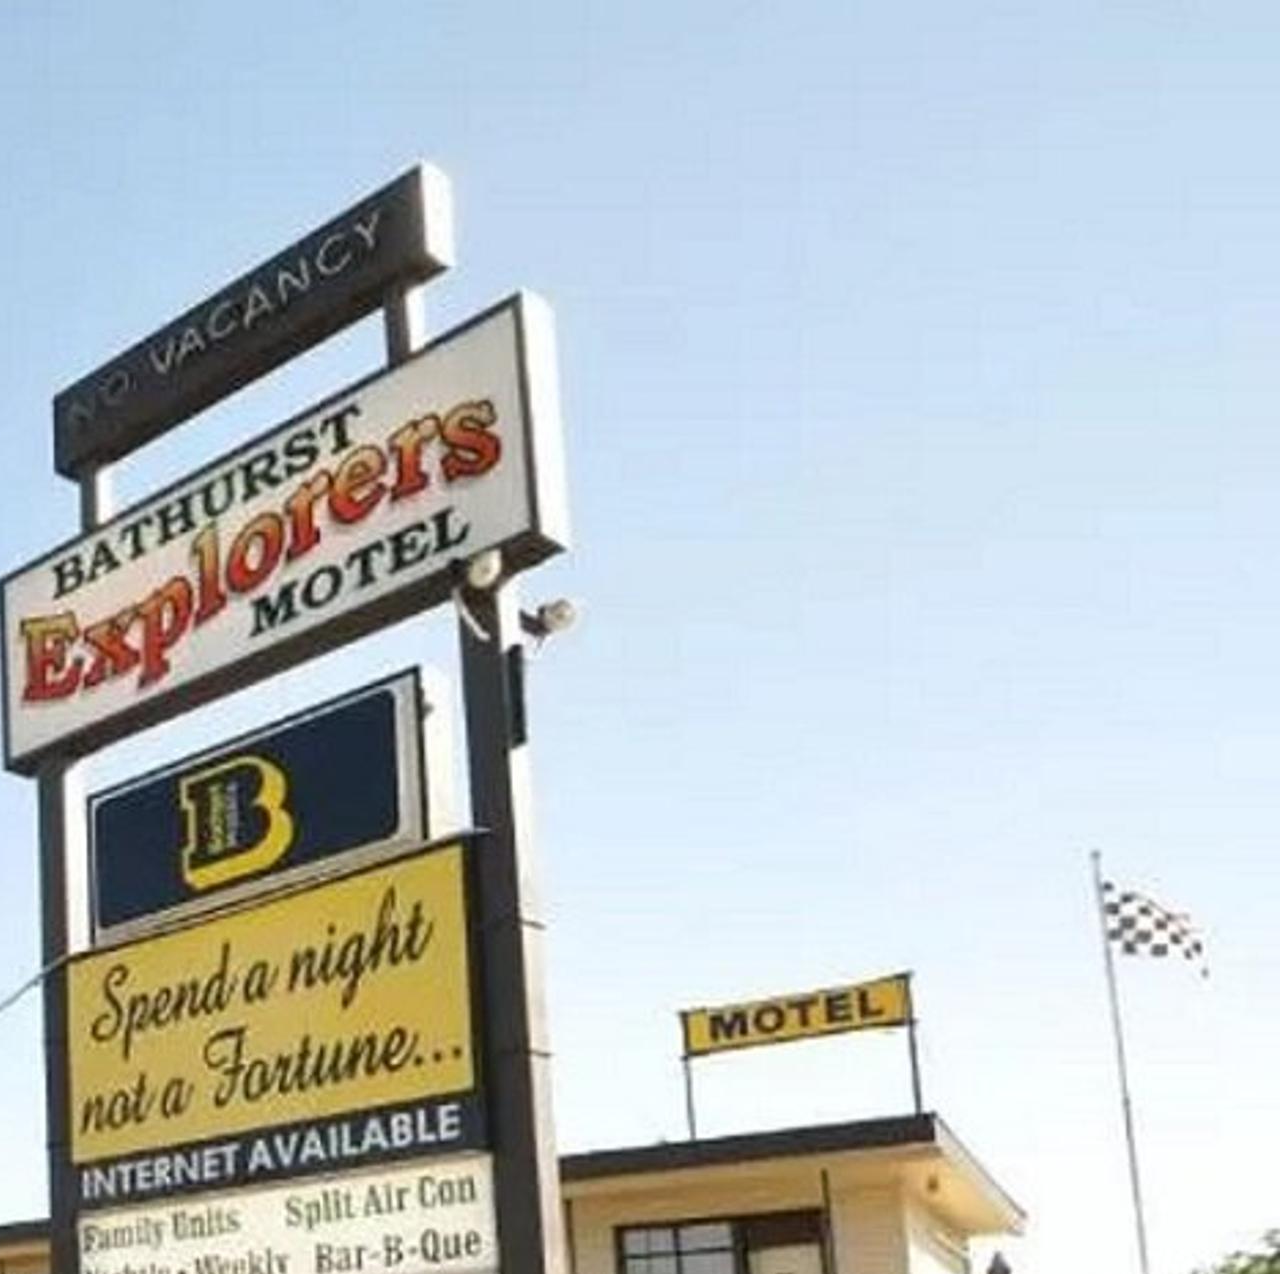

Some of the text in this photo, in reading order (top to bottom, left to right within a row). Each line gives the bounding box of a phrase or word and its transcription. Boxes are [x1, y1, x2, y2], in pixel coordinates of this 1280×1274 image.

[67, 211, 382, 430] NO VACANCY
[18, 398, 504, 706] Explorers
[51, 403, 362, 599] BATHURST
[248, 504, 472, 639] MOTEL
[91, 885, 436, 1061] Spend a night
[709, 988, 884, 1042] MOTEL
[80, 1073, 157, 1134] not
[161, 1080, 195, 1117] a
[81, 1104, 461, 1200] INTERNET AVAILABLE
[81, 1204, 241, 1254] Family Units
[285, 1173, 476, 1232] Split Air Con
